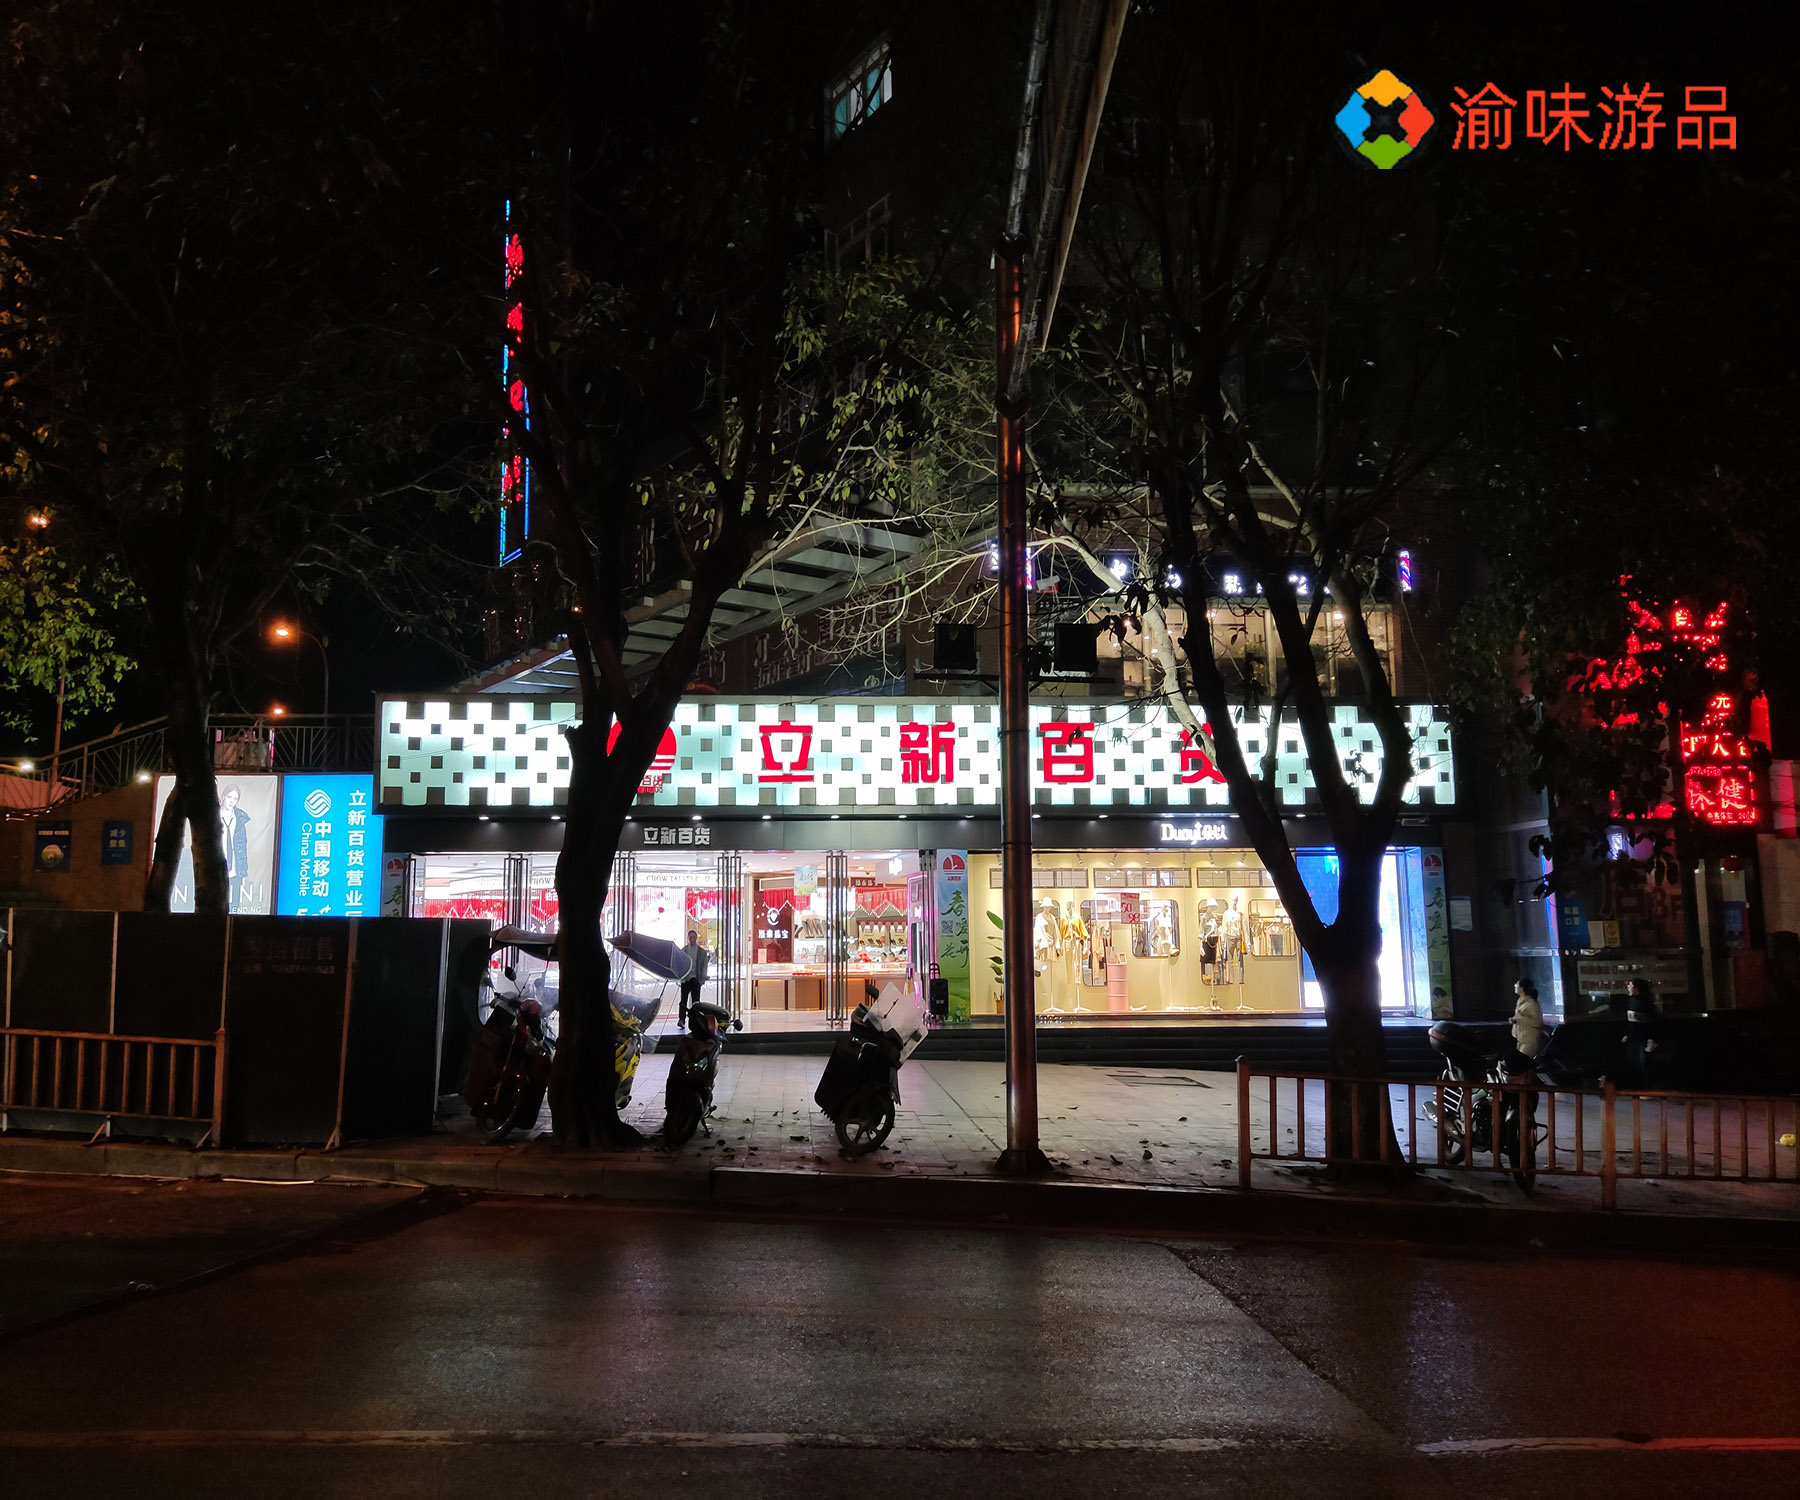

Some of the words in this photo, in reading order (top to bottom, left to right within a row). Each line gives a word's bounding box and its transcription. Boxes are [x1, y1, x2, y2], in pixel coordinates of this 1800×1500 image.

[300, 822, 312, 856] China
[643, 826, 712, 845] 立新百货
[312, 820, 332, 897] 中国移动
[298, 858, 311, 896] Mobile
[531, 877, 552, 886] HOW
